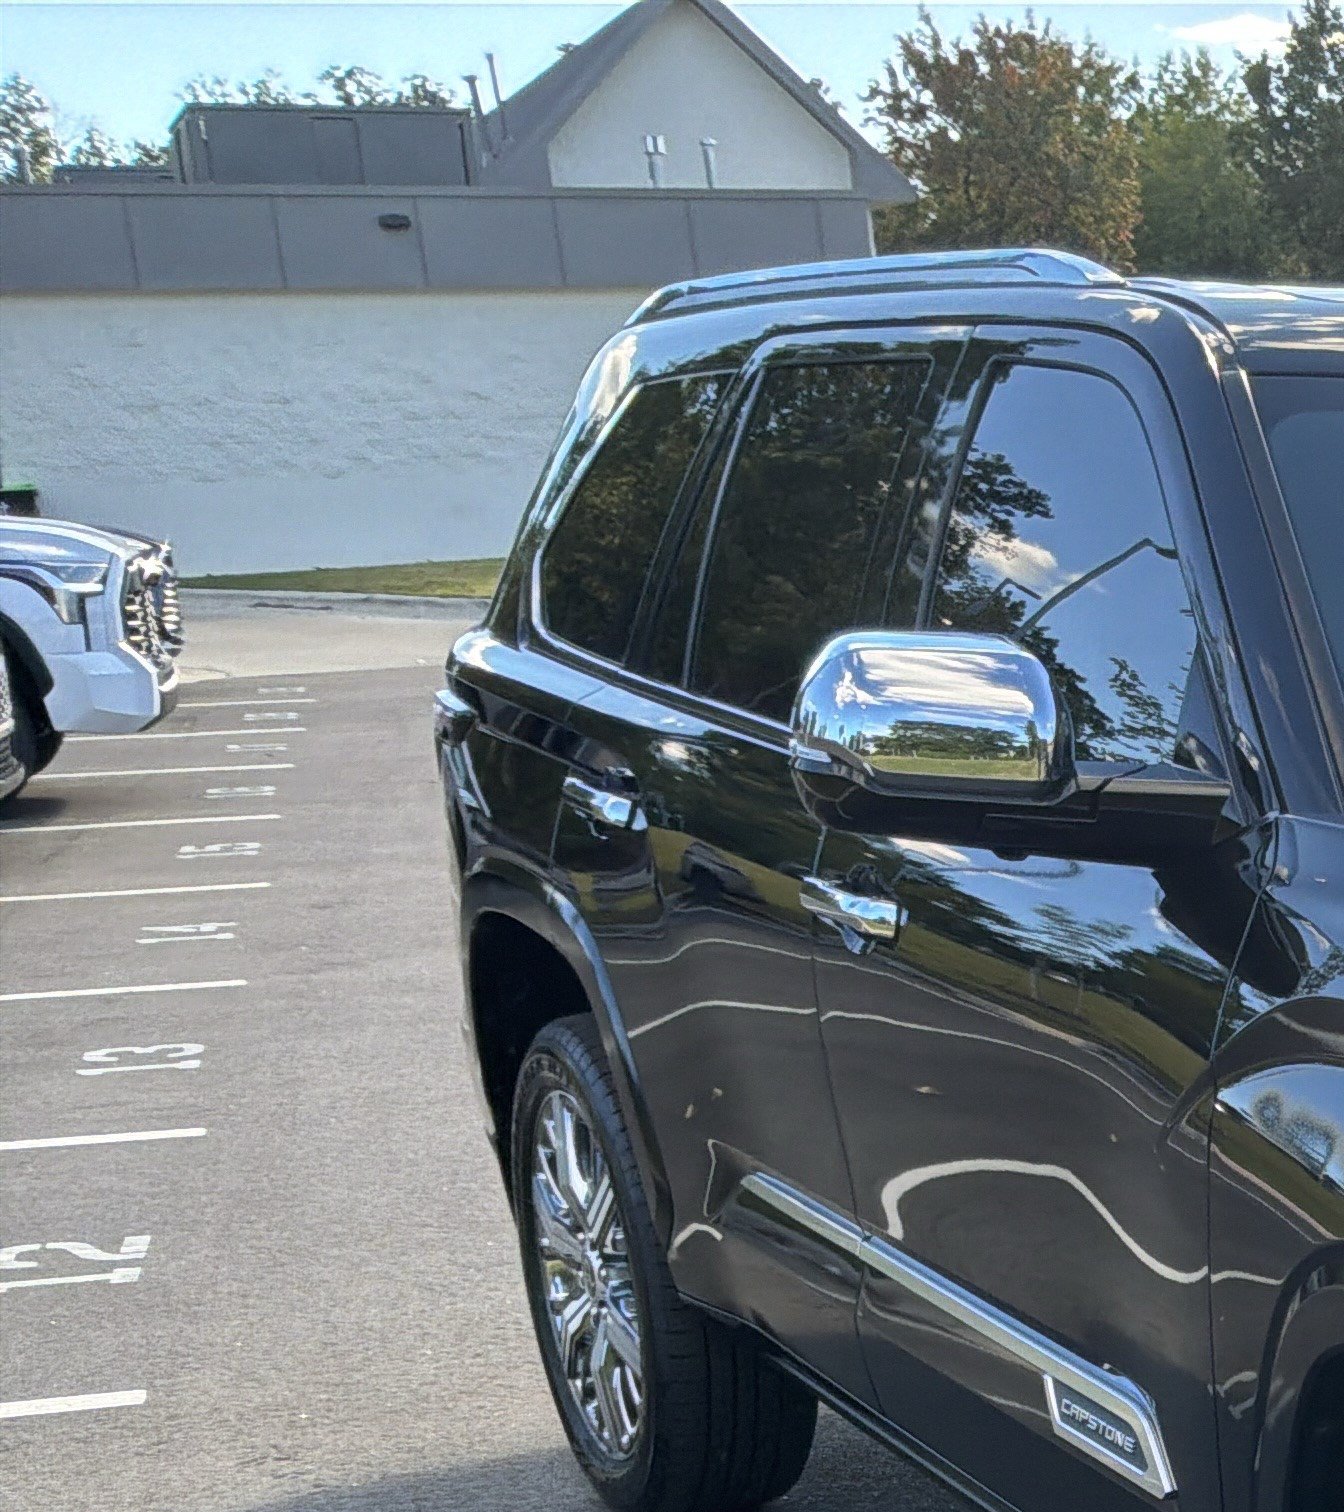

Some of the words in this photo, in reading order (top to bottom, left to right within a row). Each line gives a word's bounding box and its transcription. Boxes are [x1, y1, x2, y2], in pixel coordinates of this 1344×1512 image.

[135, 919, 240, 944] 14
[75, 1043, 205, 1076] 13
[0, 1235, 151, 1293] 12
[1060, 1398, 1136, 1453] CAPSTONE
